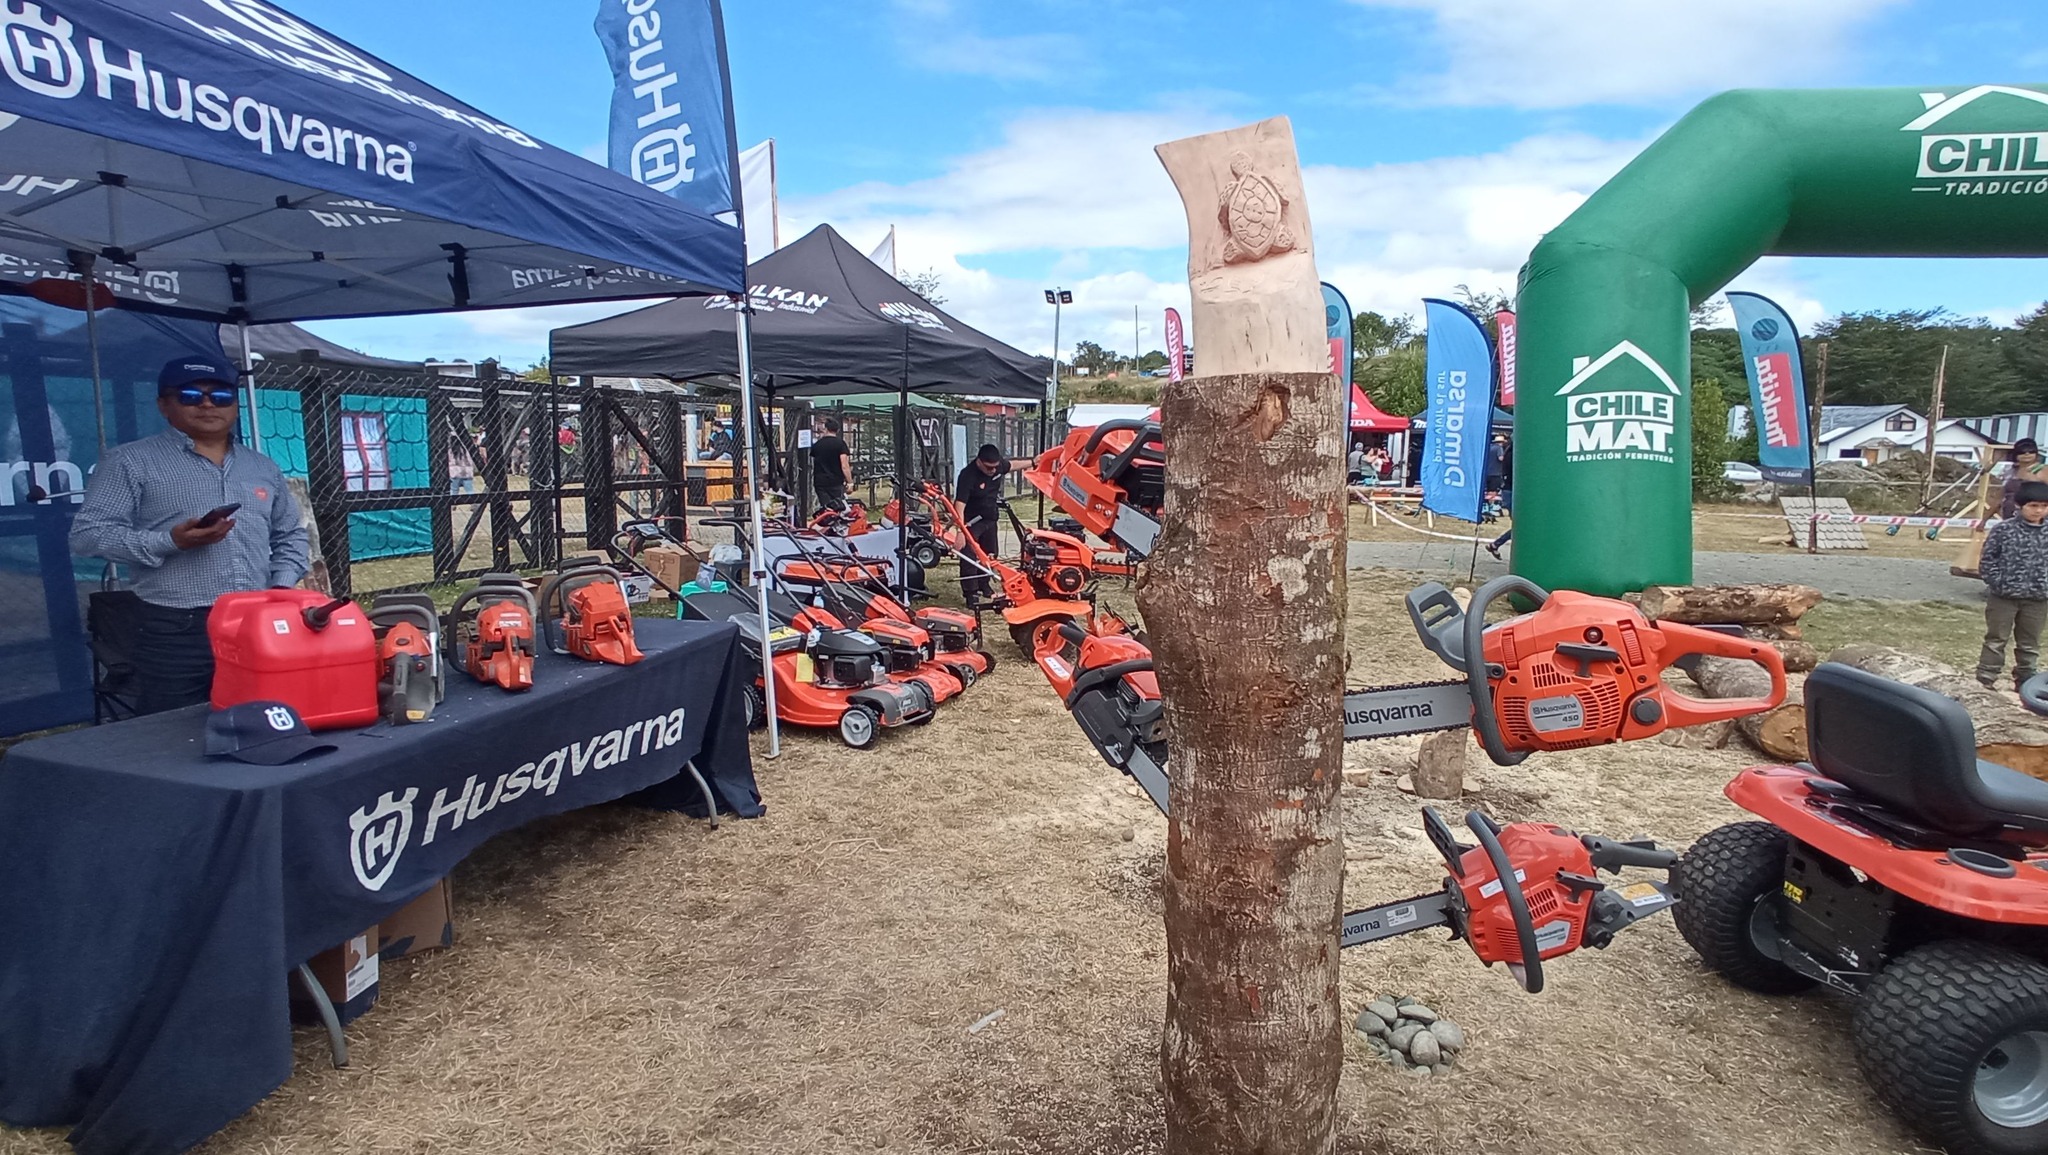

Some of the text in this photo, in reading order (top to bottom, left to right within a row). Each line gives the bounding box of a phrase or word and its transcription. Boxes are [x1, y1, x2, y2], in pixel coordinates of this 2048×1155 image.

[1574, 395, 1668, 418] CHILE
[1567, 451, 1673, 463] TRADICIÓN FERRETERA
[1541, 703, 1577, 713] Husqvarna
[421, 707, 685, 846] Husqvarna
